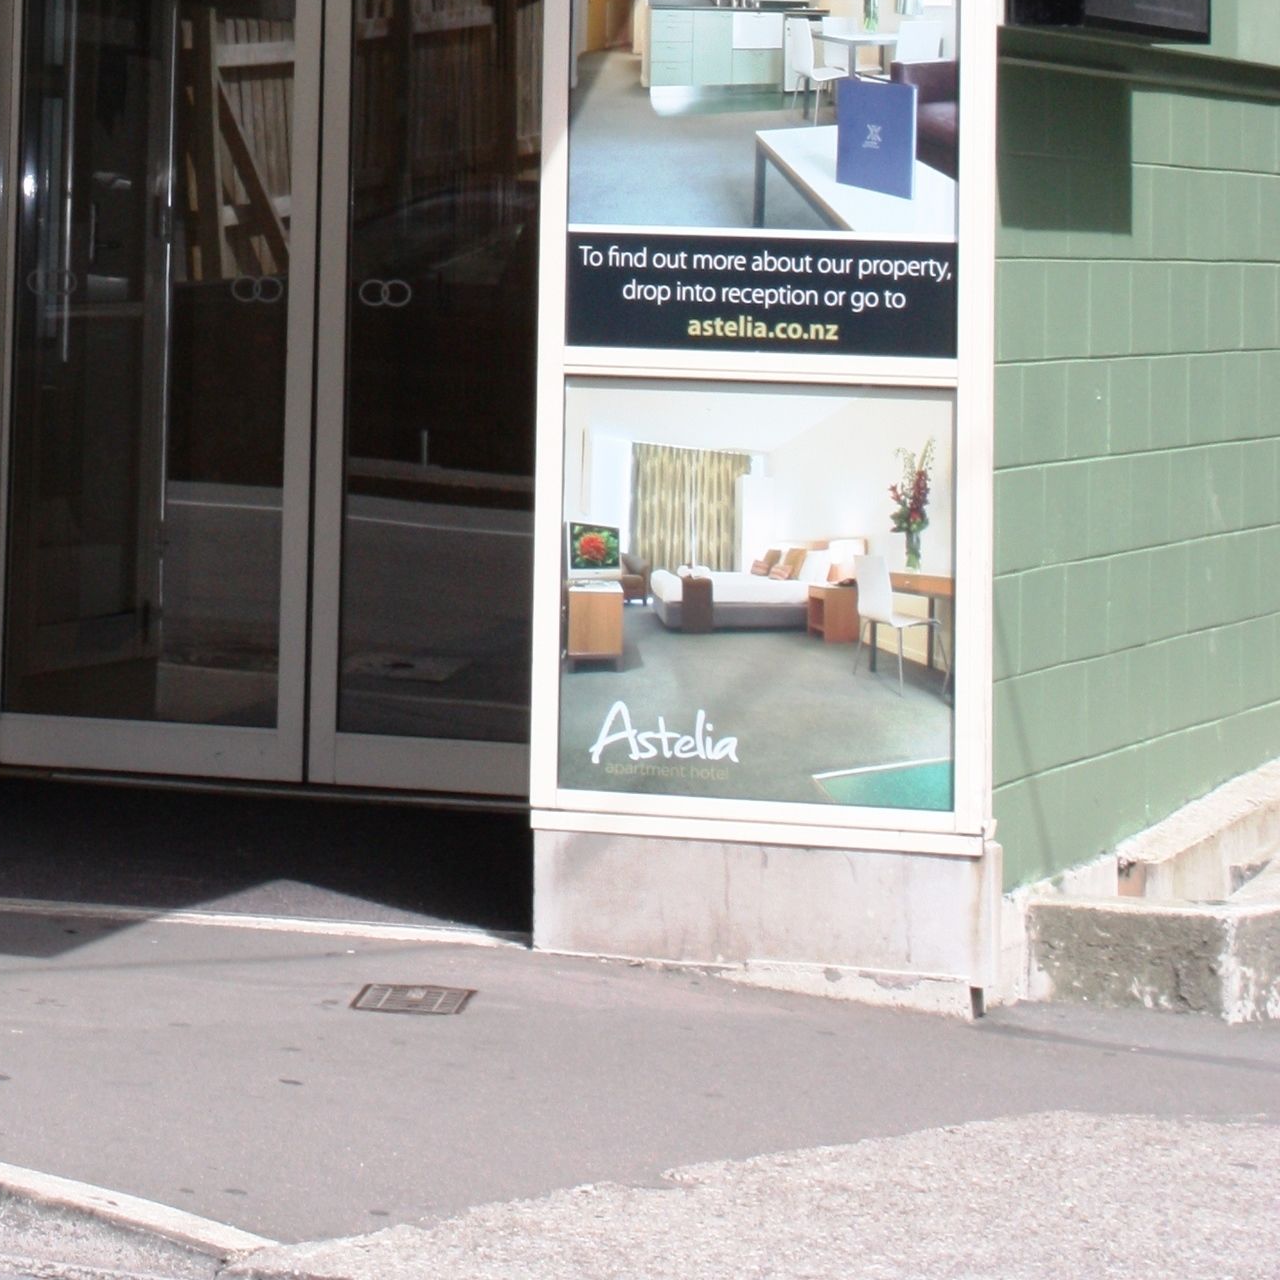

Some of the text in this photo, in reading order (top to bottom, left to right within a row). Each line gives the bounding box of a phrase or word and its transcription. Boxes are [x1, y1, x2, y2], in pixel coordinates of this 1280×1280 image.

[579, 245, 952, 282] To find out more about our property,
[623, 279, 906, 312] drop into reception or go to
[687, 316, 839, 341] astelia.co.nz
[588, 700, 740, 764] Astelia
[604, 761, 730, 782] apartment hotel
